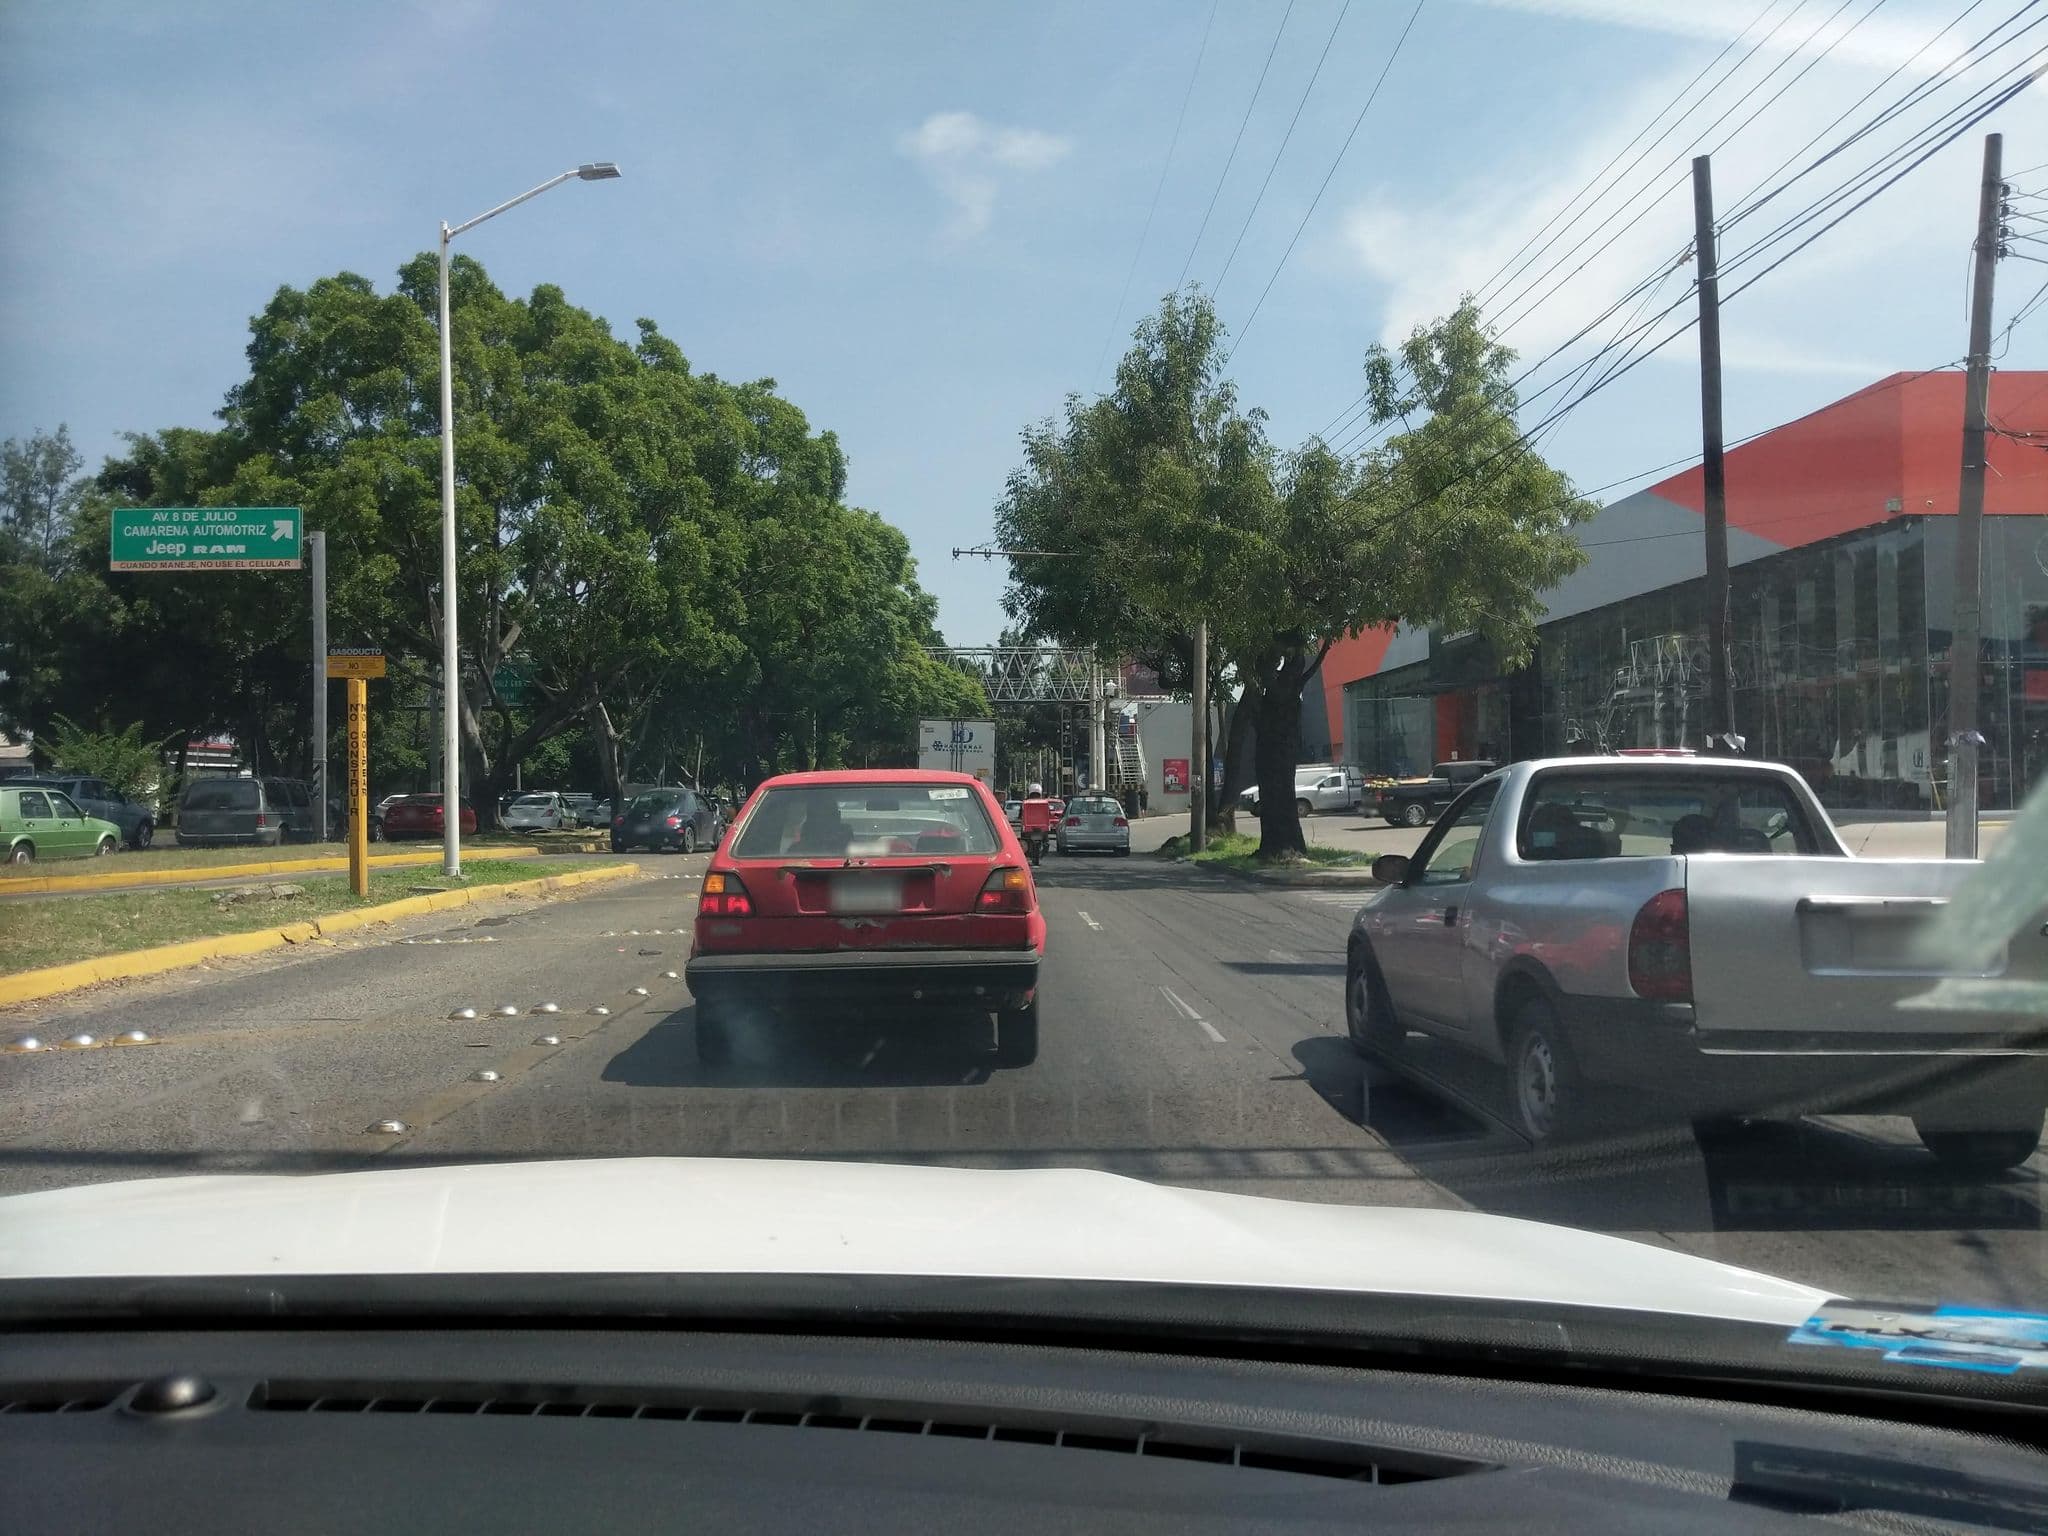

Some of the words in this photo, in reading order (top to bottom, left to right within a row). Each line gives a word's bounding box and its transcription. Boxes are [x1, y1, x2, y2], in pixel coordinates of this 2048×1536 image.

[152, 512, 169, 522] AV.
[172, 512, 180, 522] 8
[182, 512, 199, 522] DE
[202, 511, 237, 521] JULIO
[123, 525, 189, 537] CAMARENA
[193, 524, 267, 536] AUTOMOTRIZ
[146, 539, 187, 557] Jeep
[192, 544, 246, 554] RAM
[120, 561, 158, 569] CUANDO
[160, 560, 199, 569] MANEJE,
[200, 560, 213, 568] NO
[215, 560, 233, 568] USE
[235, 560, 246, 568] EL
[248, 560, 291, 568] CELULAR
[329, 648, 382, 656] GASODUCTO
[350, 703, 359, 722] NO
[350, 730, 359, 817] CONSTRUIR
